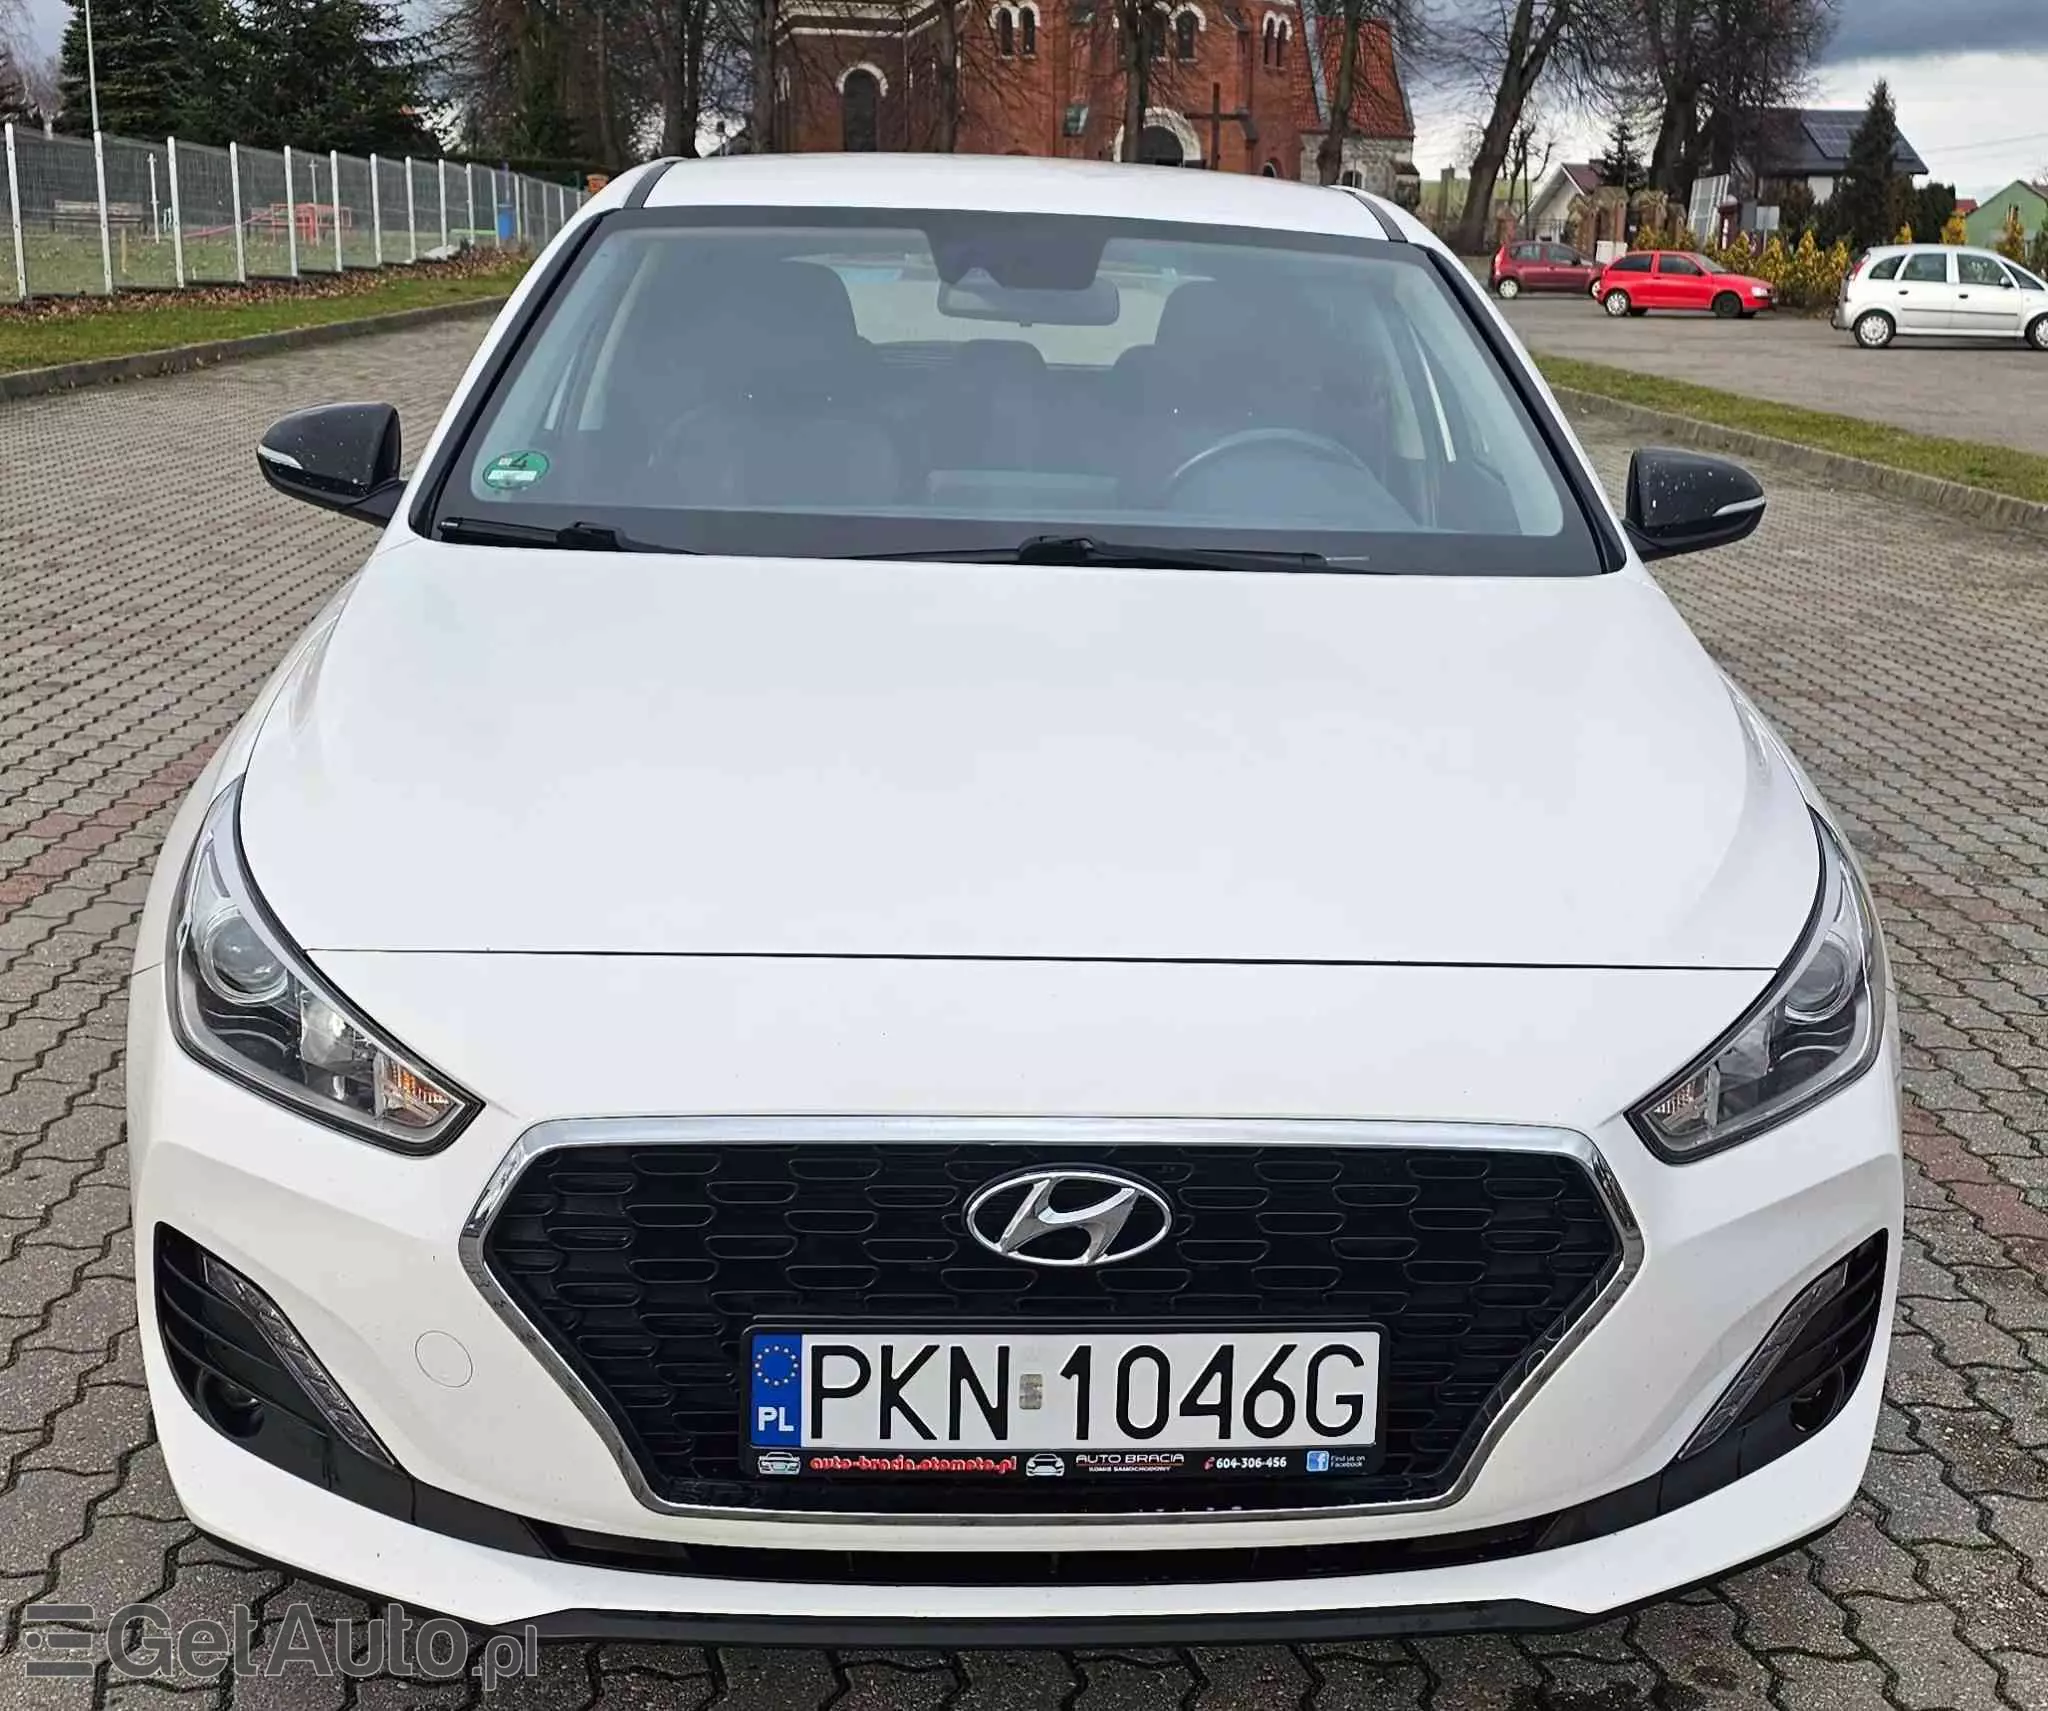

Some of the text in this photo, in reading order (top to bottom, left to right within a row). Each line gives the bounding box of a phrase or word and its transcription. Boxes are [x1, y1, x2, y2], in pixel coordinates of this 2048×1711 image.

[810, 1343, 1365, 1441] PKN 1046G
[757, 1406, 795, 1432] PL
[809, 1454, 1017, 1474] auto-bracia.otomoto.pl
[1075, 1453, 1185, 1464] AUTO BRACIA
[1215, 1456, 1287, 1470] 604-306-456
